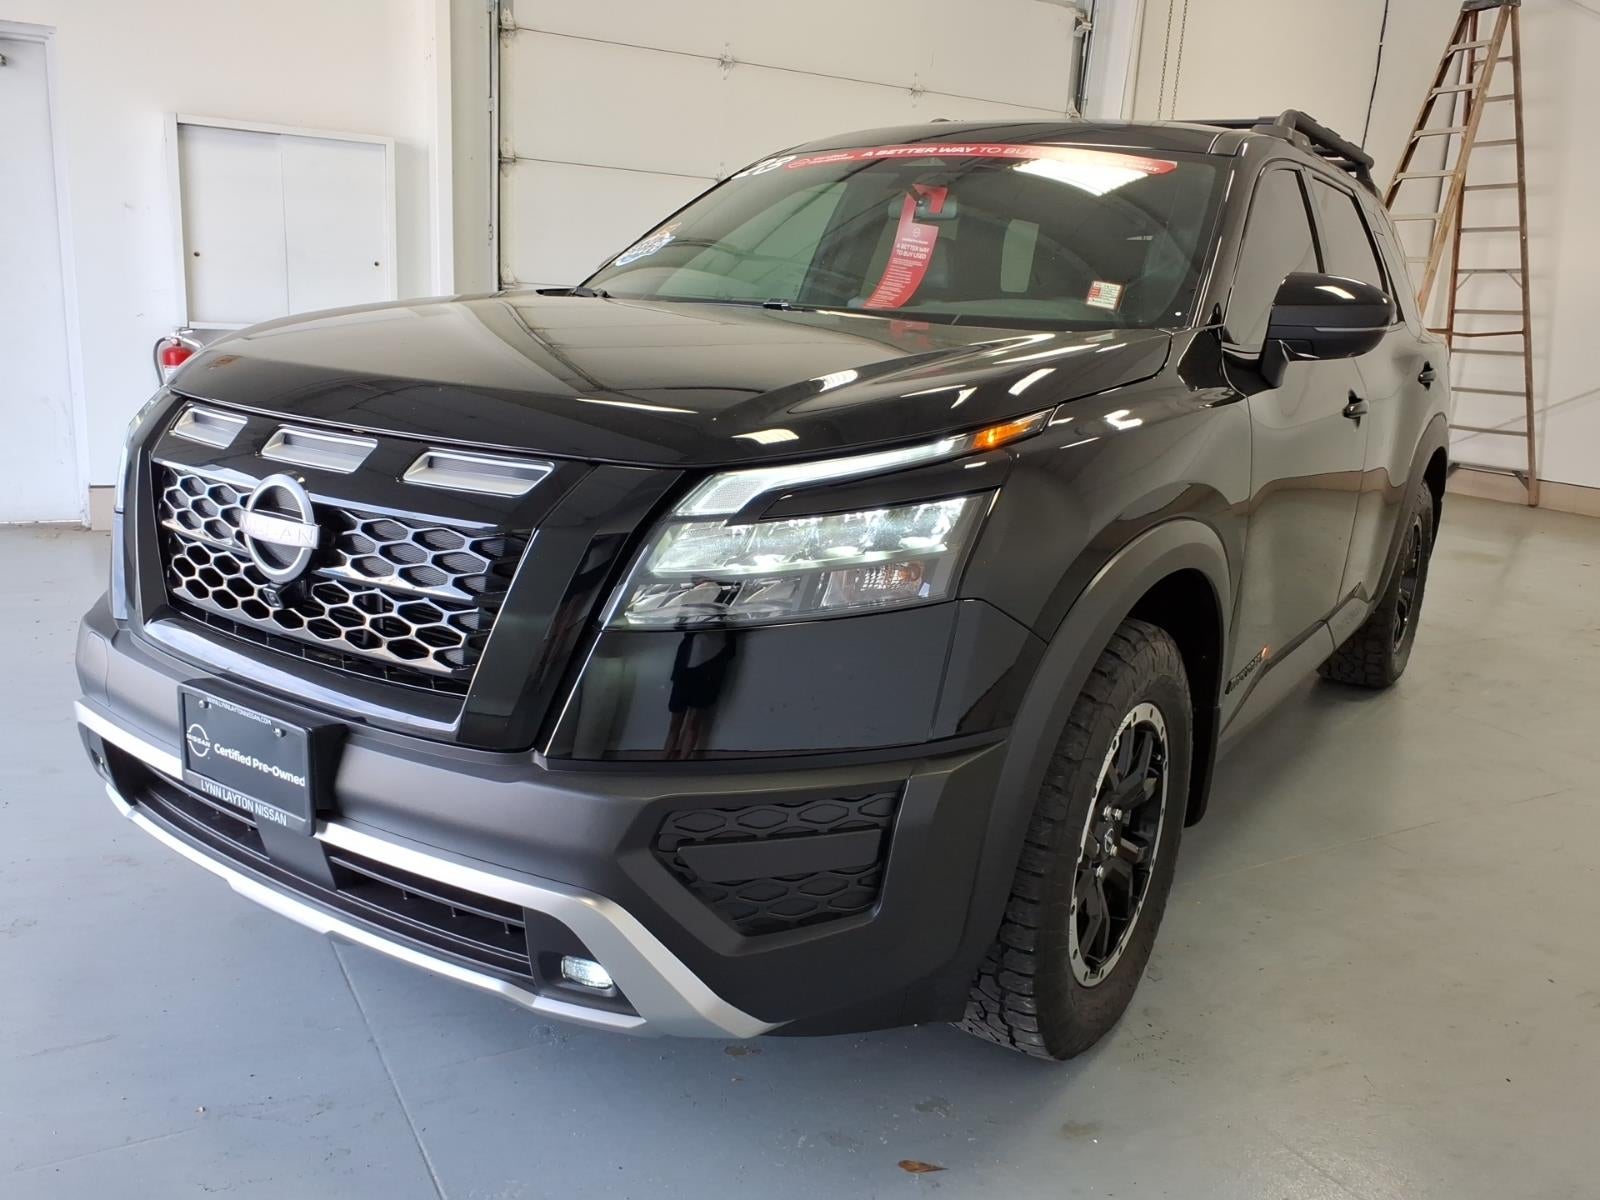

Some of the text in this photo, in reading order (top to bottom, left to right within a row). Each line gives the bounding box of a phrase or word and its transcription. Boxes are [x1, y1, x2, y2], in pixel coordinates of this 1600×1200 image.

[874, 147, 937, 156] BETTER
[186, 733, 211, 747] NISSAN
[214, 743, 305, 787] Certified Pre-Owned
[200, 779, 287, 826] LYNN LAYTON NISSAN
